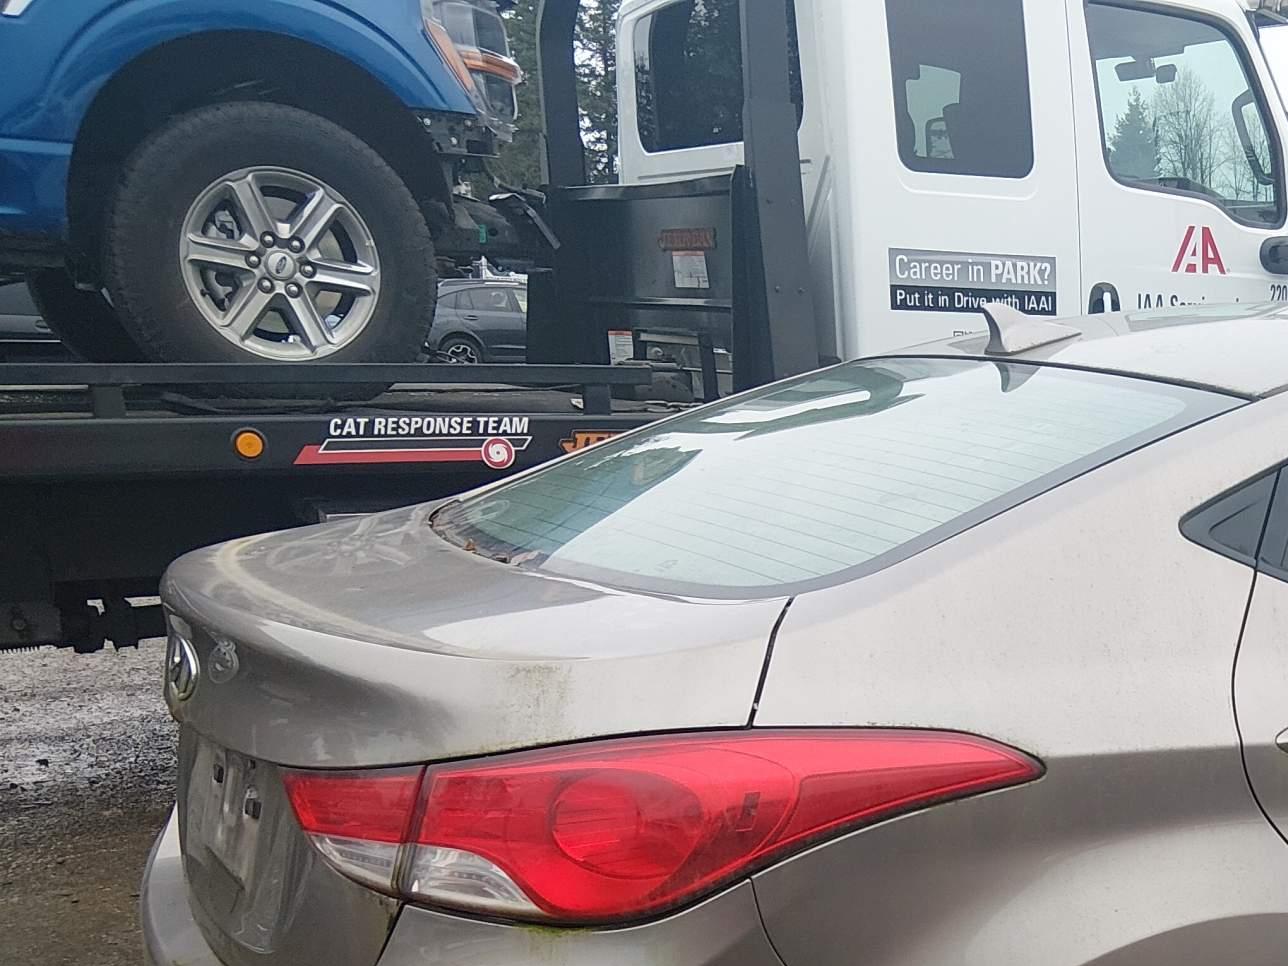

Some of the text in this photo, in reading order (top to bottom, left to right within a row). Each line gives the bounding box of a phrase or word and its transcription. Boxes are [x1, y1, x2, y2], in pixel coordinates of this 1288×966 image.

[895, 254, 1051, 285] Career in PARK?
[896, 290, 921, 306] Put
[924, 290, 934, 307] it
[938, 291, 949, 307] in
[954, 292, 987, 308] Drive
[1024, 295, 1052, 311] IAAI
[329, 416, 529, 436] CAT RESPONSE TEAM
